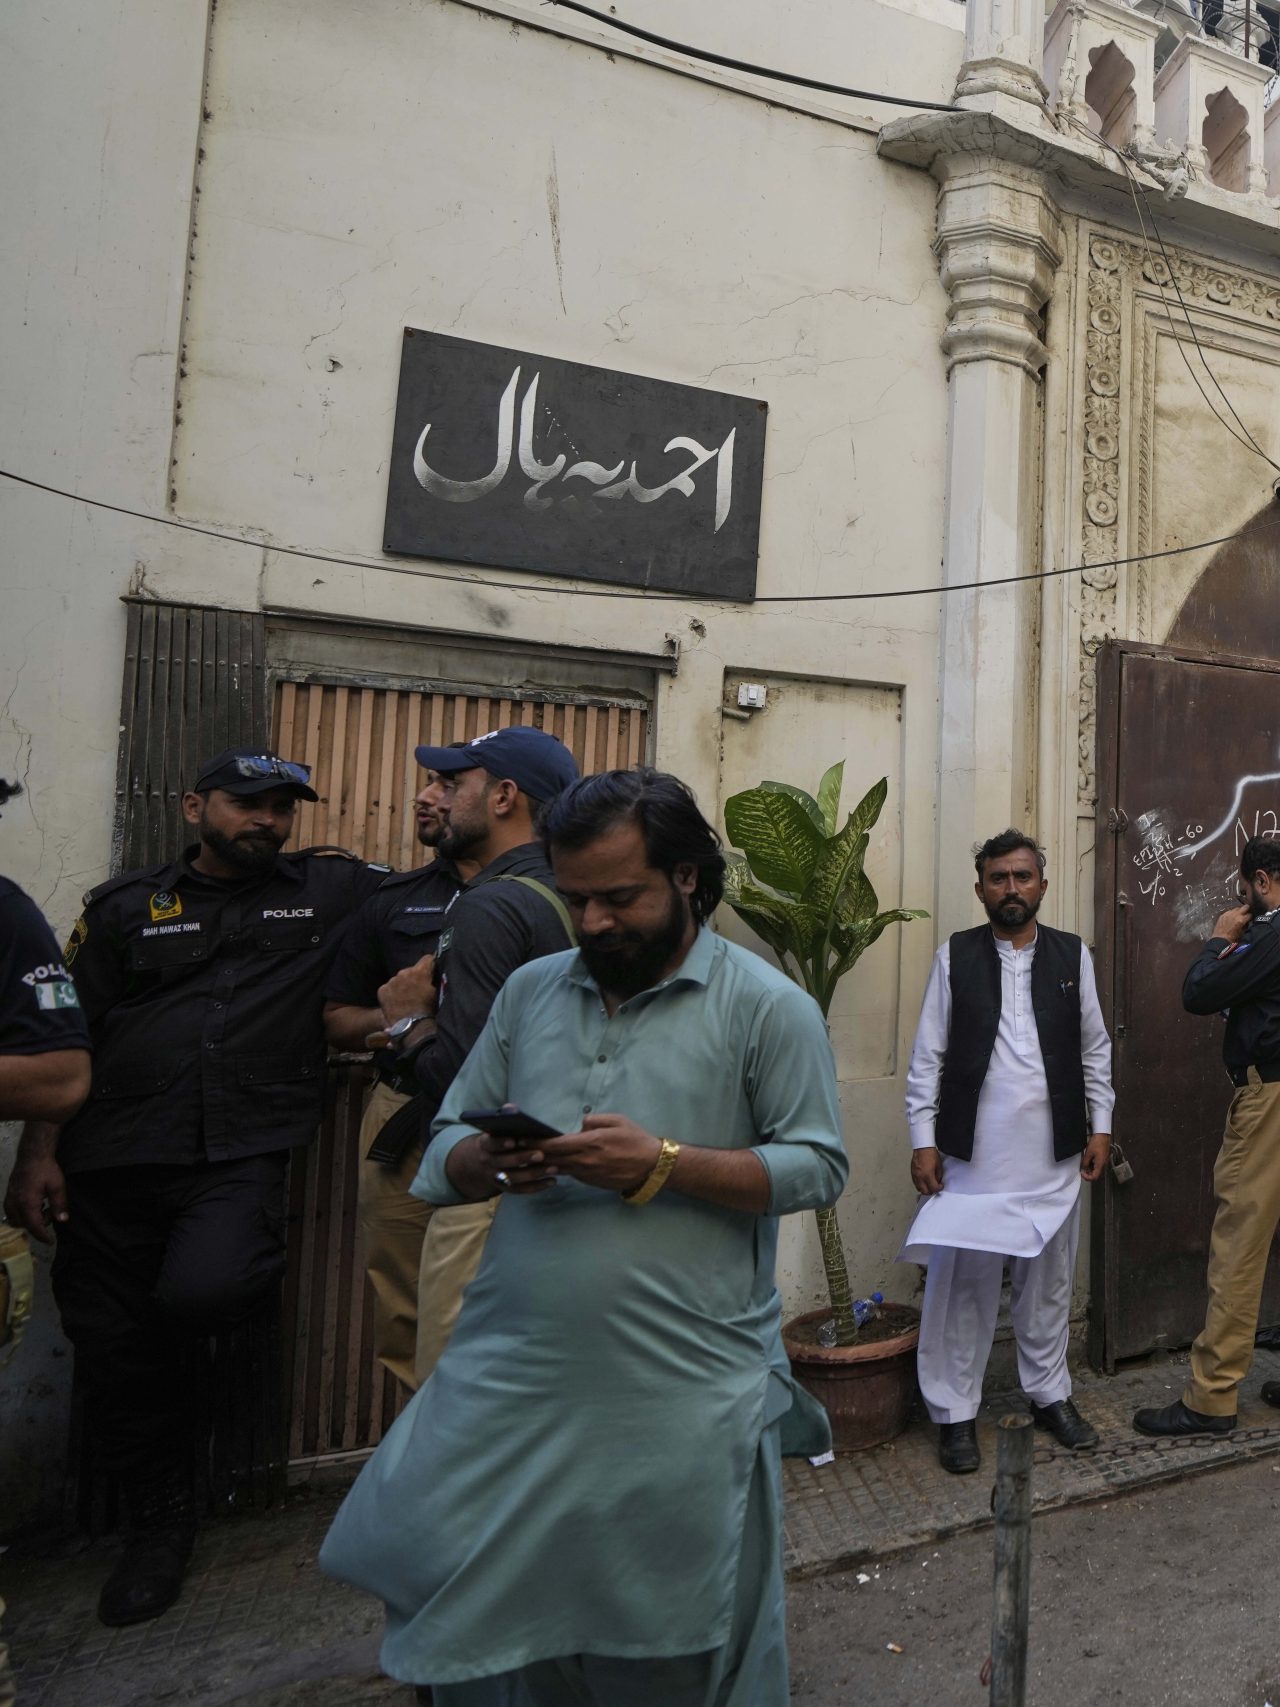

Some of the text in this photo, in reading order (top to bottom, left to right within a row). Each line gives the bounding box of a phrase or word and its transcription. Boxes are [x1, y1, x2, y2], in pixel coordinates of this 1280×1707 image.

[263, 908, 314, 919] POLICE
[142, 922, 201, 937] SHAH NAWAZ KHAN
